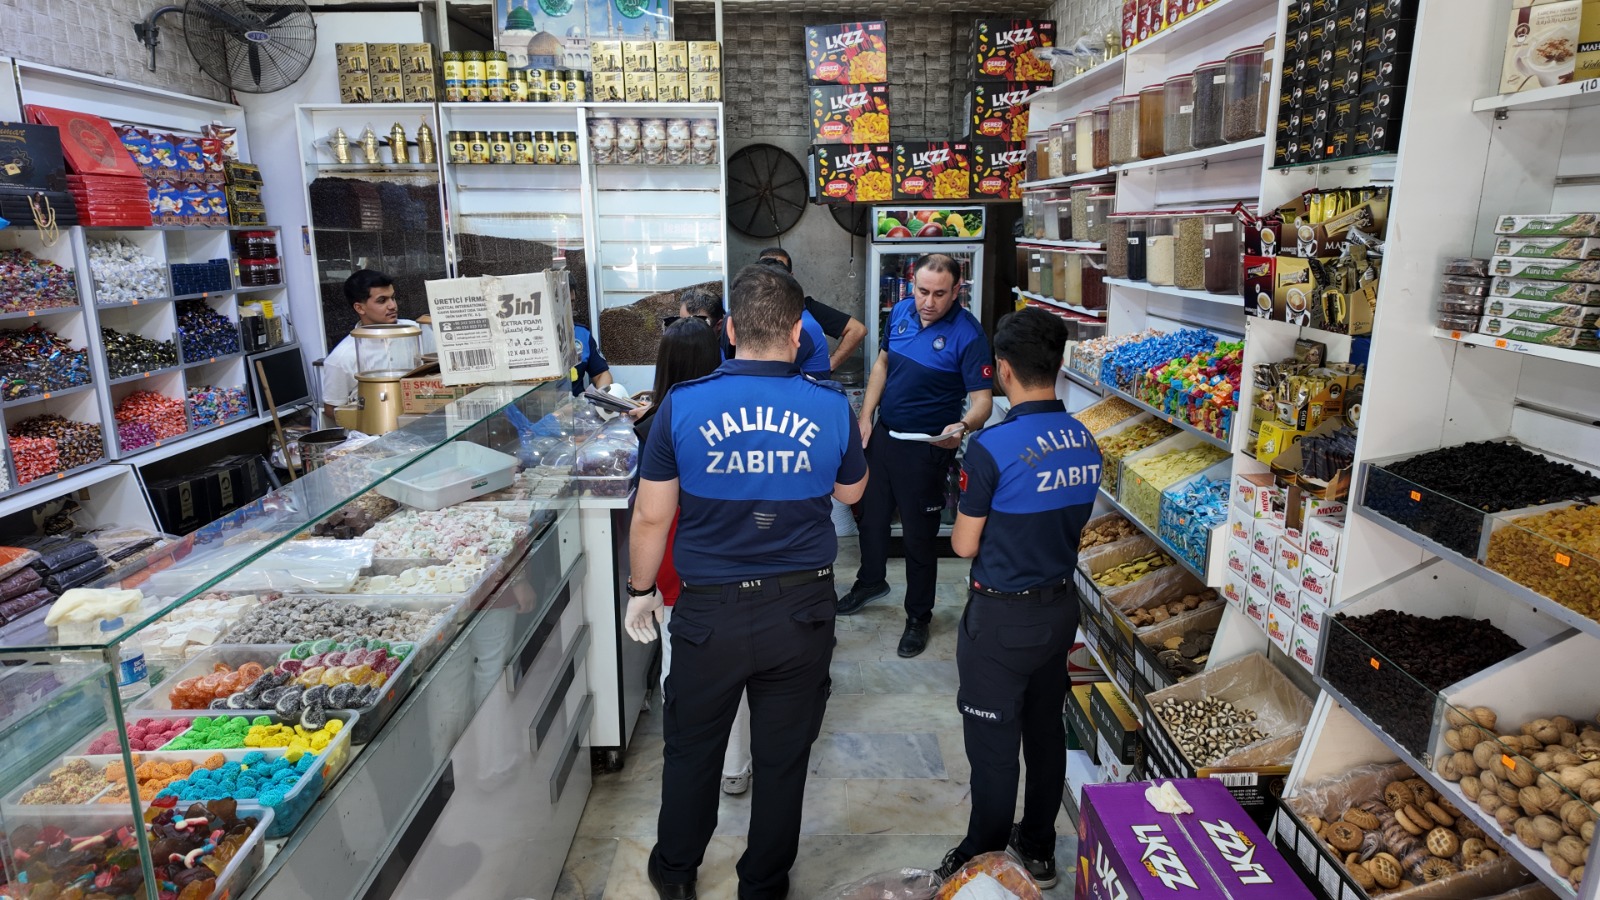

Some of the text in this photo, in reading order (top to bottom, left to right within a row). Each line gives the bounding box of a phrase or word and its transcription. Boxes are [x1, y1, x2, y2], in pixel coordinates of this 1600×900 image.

[826, 30, 864, 49] LKZZ
[996, 28, 1034, 45] LKZZ
[1581, 43, 1600, 52] MAH
[1580, 79, 1597, 93] 110
[830, 91, 869, 110] LKZZ
[992, 90, 1030, 106] LKZZ
[835, 151, 873, 168] LKZZ
[912, 148, 950, 166] LKZZ
[991, 150, 1026, 165] LKZZ
[434, 296, 462, 305] ÜRETİCİ
[496, 291, 541, 318] 3in1
[706, 450, 812, 474] ZABITA
[1317, 506, 1342, 515] MEYZO
[1257, 545, 1269, 554] MEYZO
[1311, 546, 1329, 557] MEYZO
[1303, 581, 1322, 594] MEYZO
[1302, 617, 1319, 631] MEYZO
[964, 705, 997, 719] ZABITA
[1131, 824, 1200, 891] LKZZ
[1199, 819, 1274, 885] LKZZ
